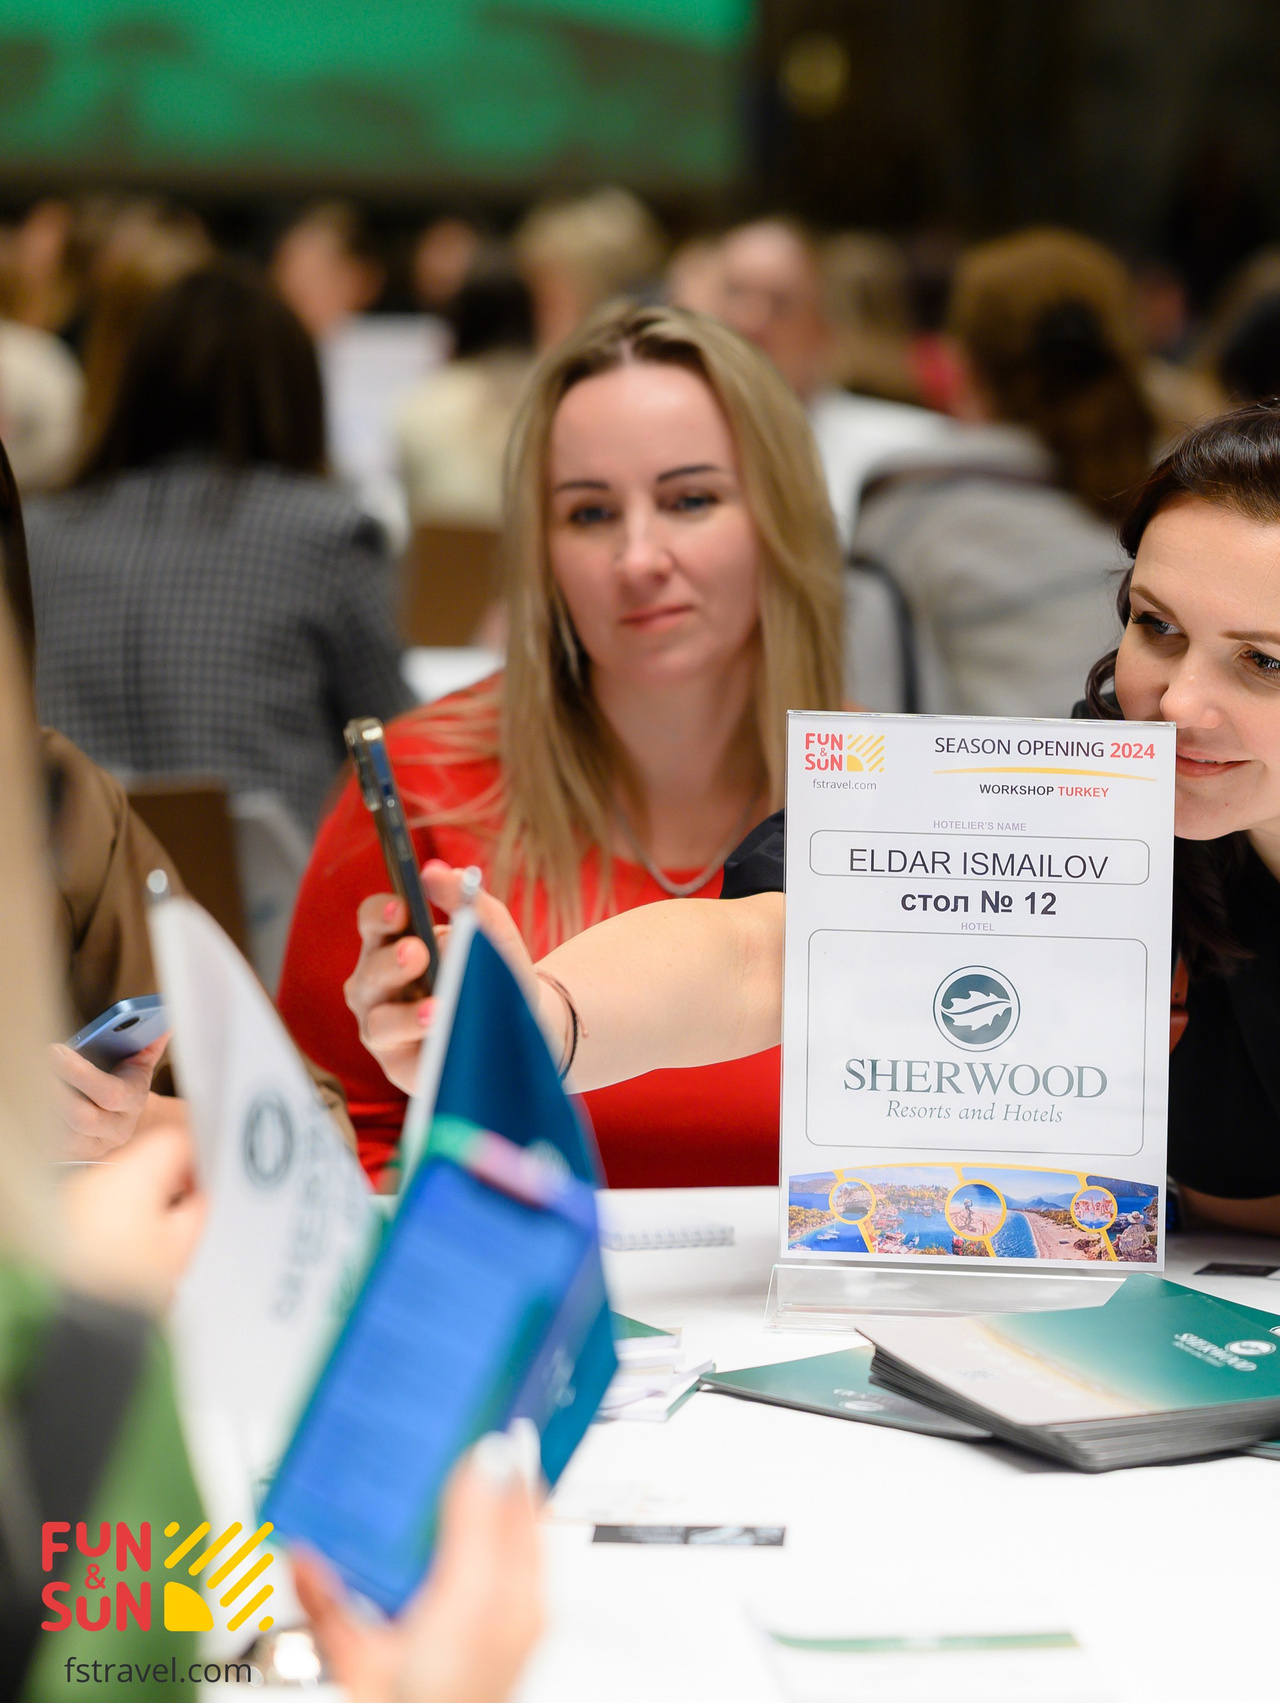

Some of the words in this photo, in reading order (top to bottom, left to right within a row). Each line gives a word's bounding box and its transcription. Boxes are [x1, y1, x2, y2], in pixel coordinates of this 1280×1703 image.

[805, 732, 843, 752] FUN
[934, 737, 1012, 755] SEASON
[1017, 739, 1105, 758] OPENING
[1110, 742, 1156, 760] 2024
[819, 747, 828, 757] &
[805, 754, 843, 772] SUN
[812, 778, 877, 791] fstravel.com
[979, 784, 1054, 797] WORKSHOP
[1058, 786, 1109, 798] TURKEY
[933, 820, 995, 831] HOTELIER'S
[997, 821, 1027, 832] NAME
[849, 848, 951, 875] ELDAR
[962, 851, 1109, 880] ISMAILOV
[901, 892, 970, 913] стол
[981, 890, 1013, 914] №
[1025, 892, 1057, 916] 12
[960, 921, 995, 932] HOTEL
[843, 1057, 1108, 1099] SHERWOOD
[886, 1099, 952, 1120] Resorts
[958, 1102, 996, 1121] and
[1003, 1103, 1063, 1124] Hotels
